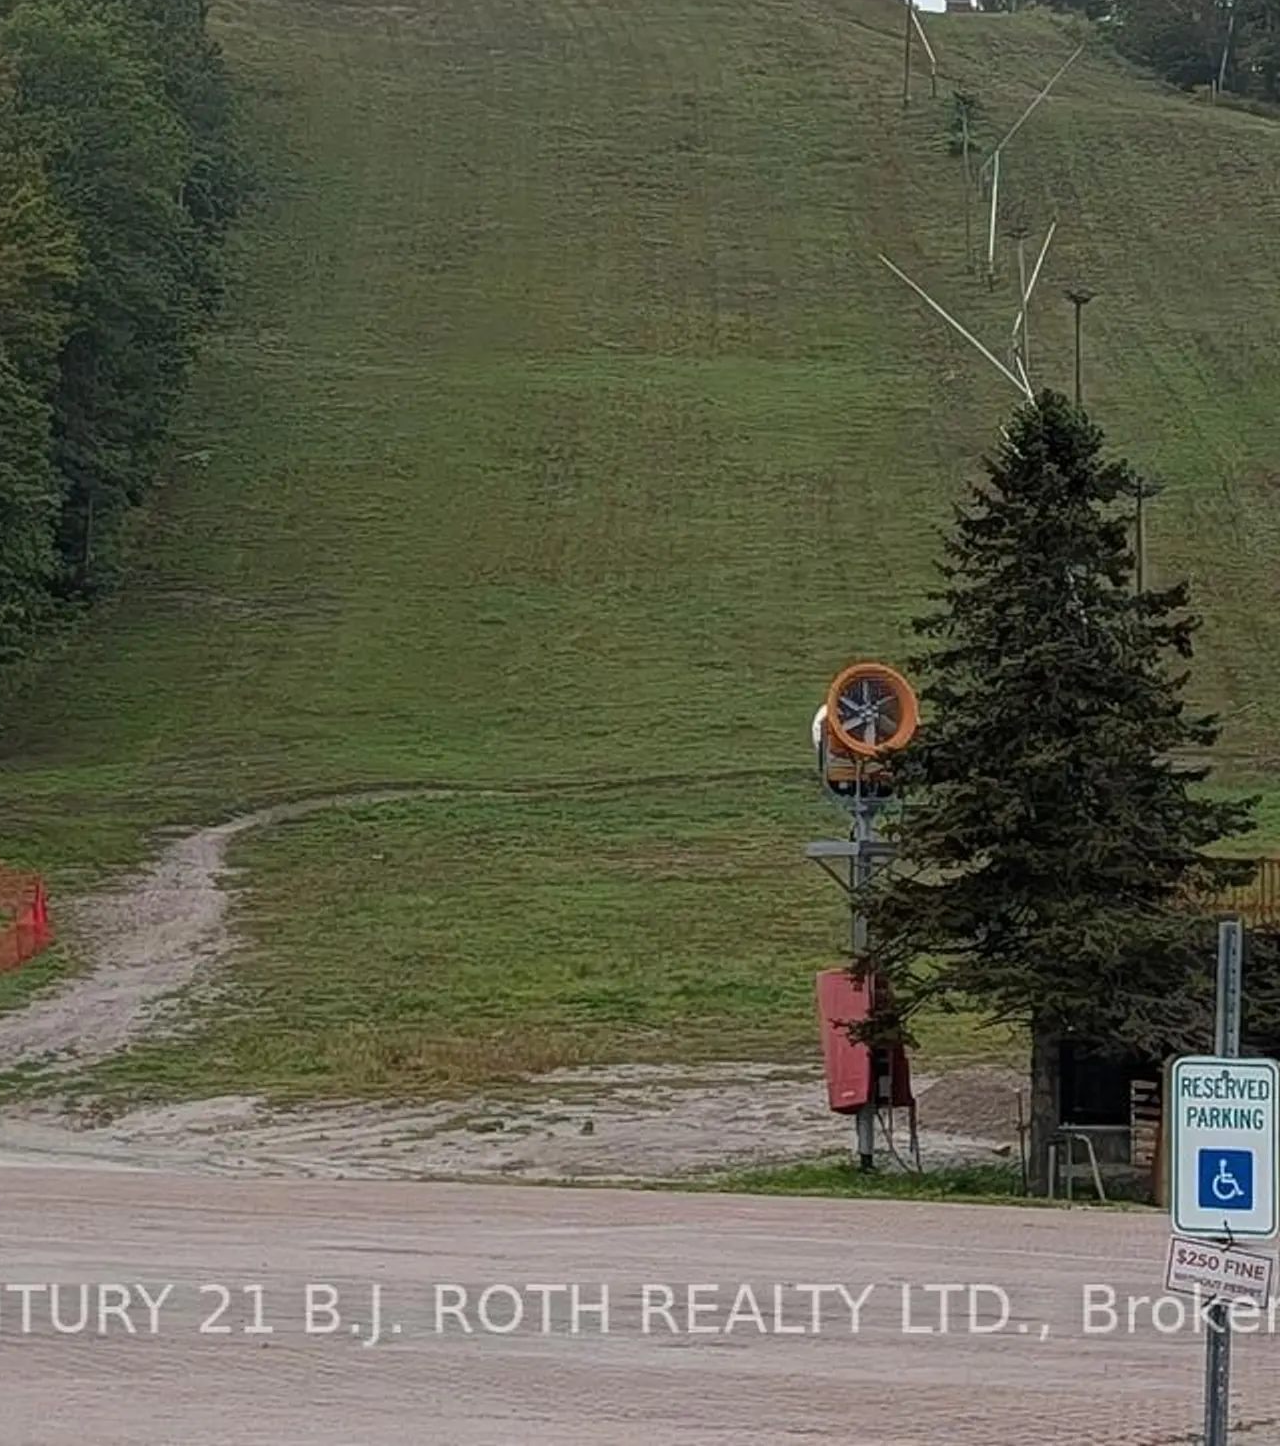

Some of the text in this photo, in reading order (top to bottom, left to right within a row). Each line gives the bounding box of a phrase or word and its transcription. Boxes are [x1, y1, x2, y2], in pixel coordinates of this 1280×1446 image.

[1181, 1076, 1269, 1101] RESERVED
[1186, 1106, 1264, 1131] PARKING
[1176, 1248, 1266, 1281] $250 FINE
